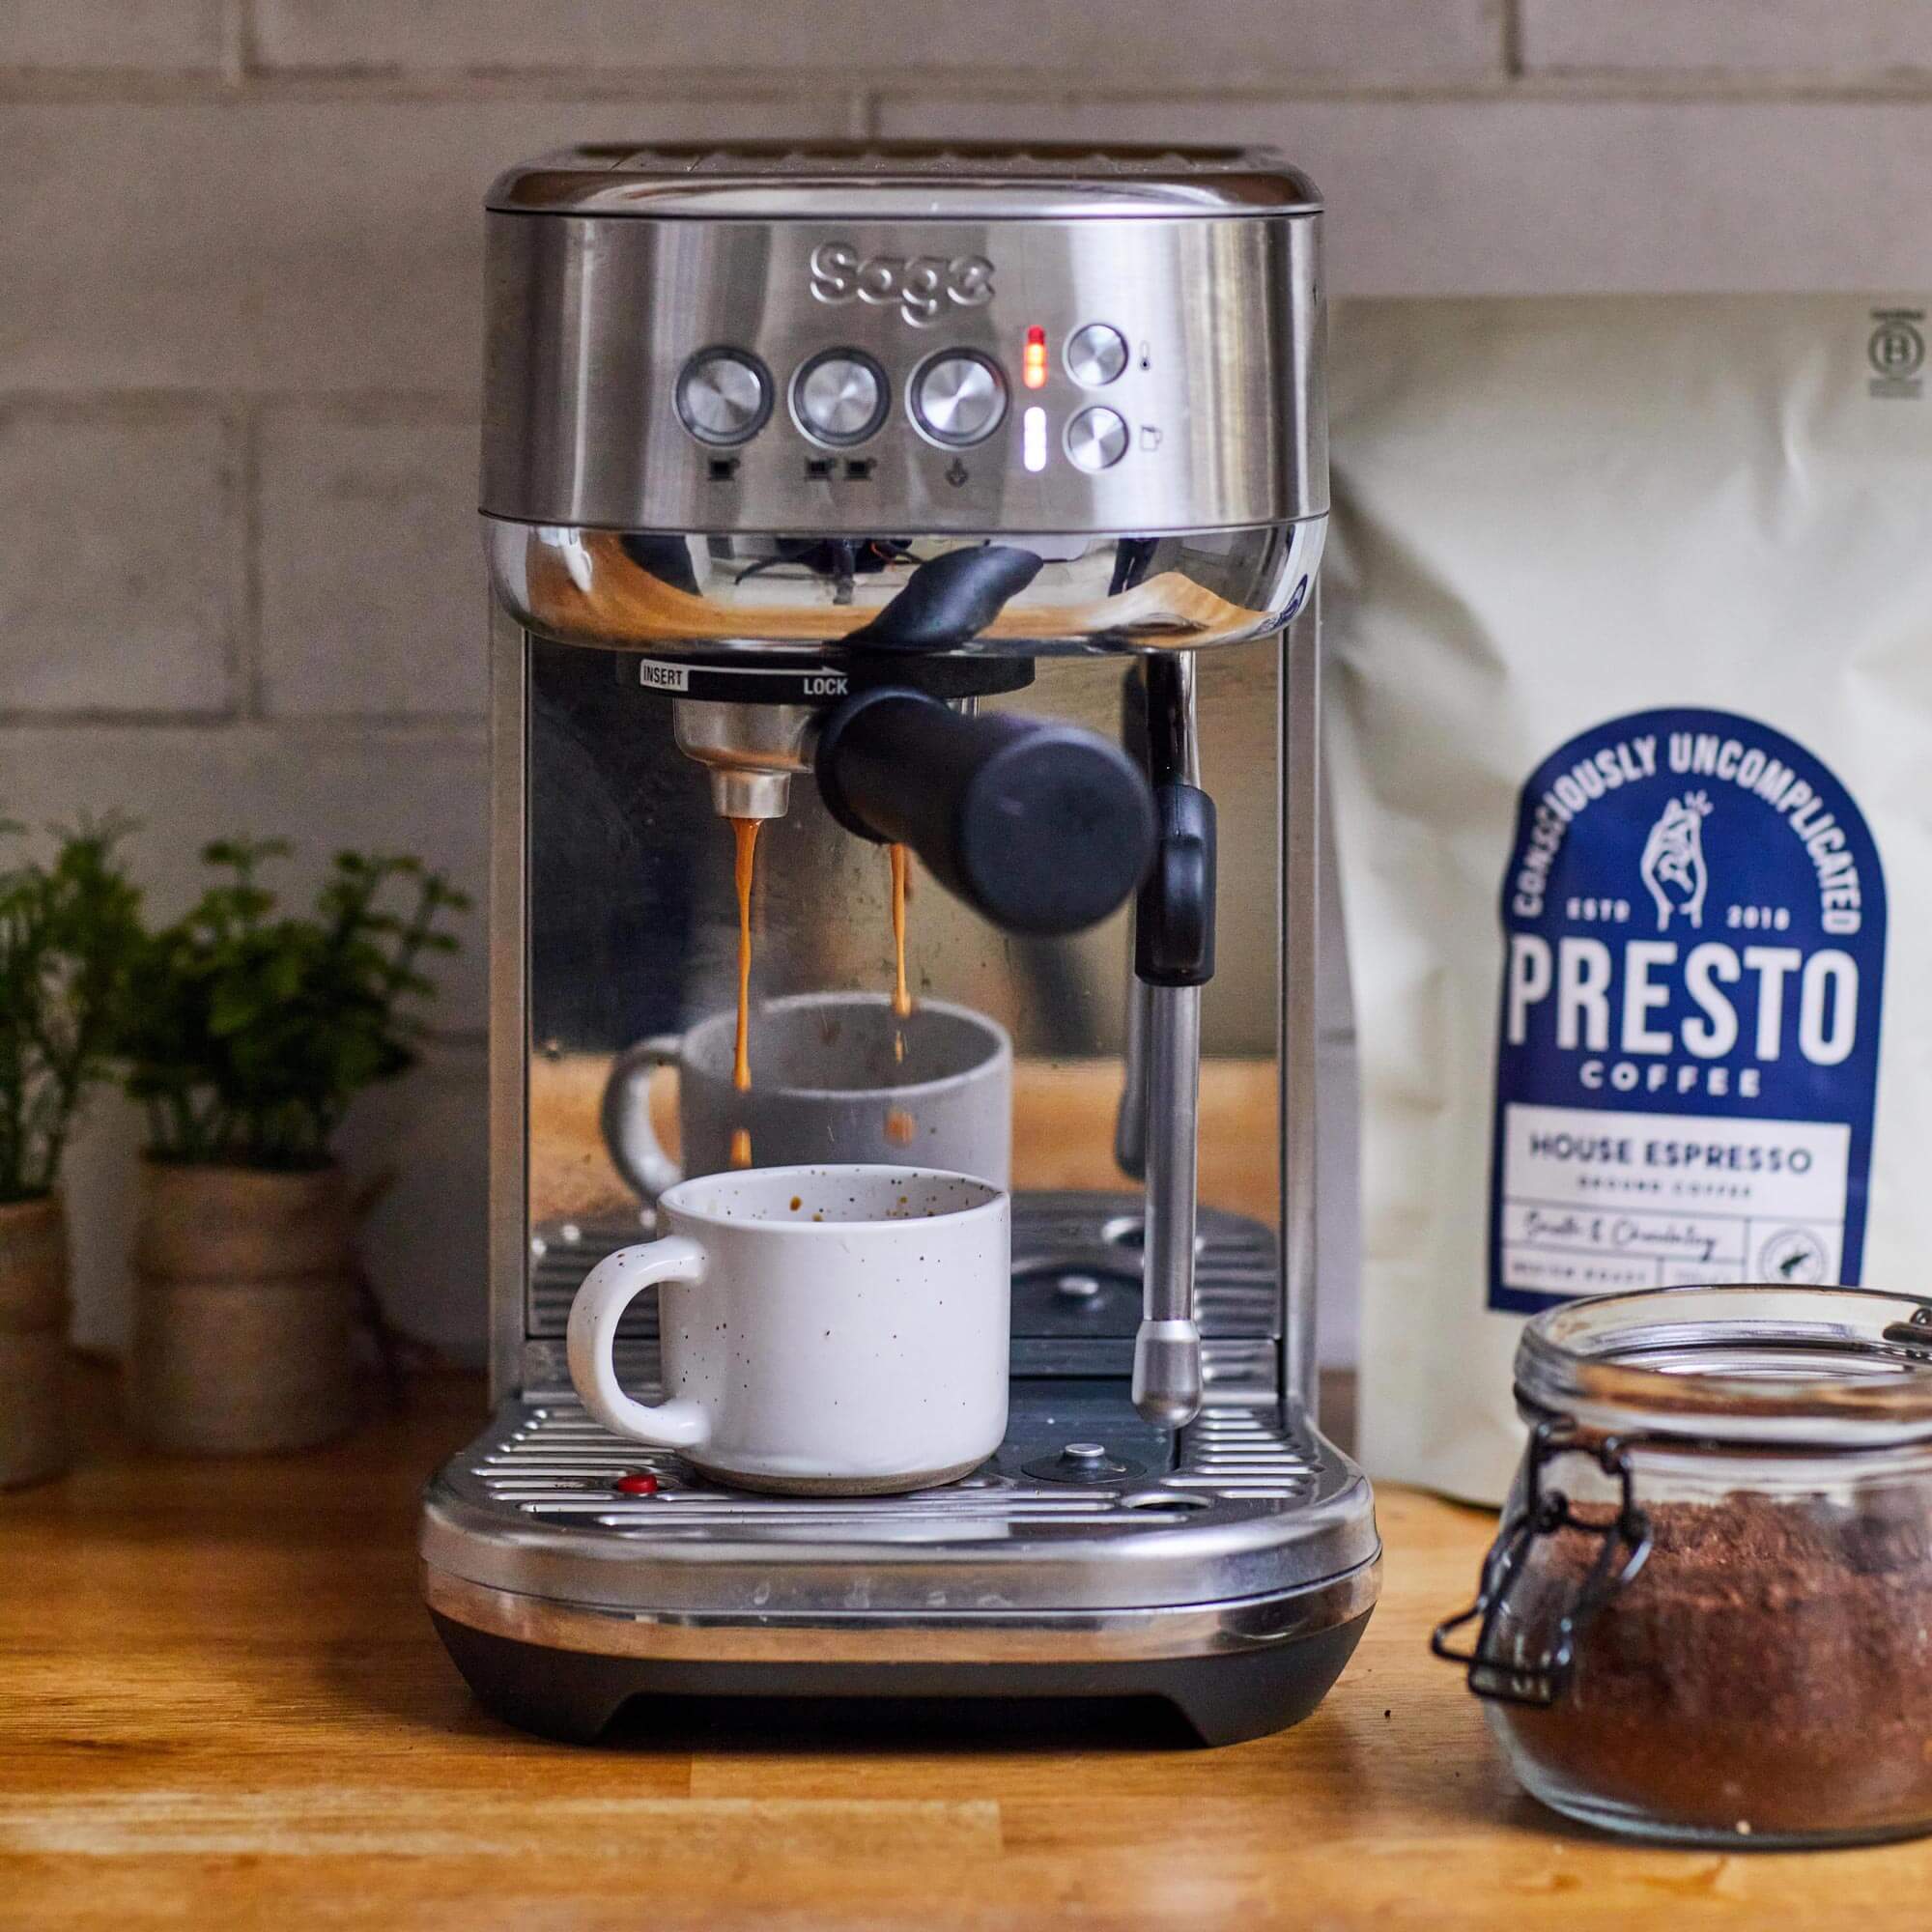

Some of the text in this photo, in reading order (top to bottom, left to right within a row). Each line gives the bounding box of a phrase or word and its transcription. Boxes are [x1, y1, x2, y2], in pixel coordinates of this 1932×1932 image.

[810, 242, 995, 327] Sage
[642, 665, 683, 687] INSERT
[803, 677, 848, 696] LOCK
[1669, 732, 1861, 934] UNCOMPLICATED
[1508, 933, 1859, 1065] PRESTO
[1579, 1063, 1761, 1098] COFFEE
[1531, 1134, 1812, 1173] HOUSE ESPRESSO
